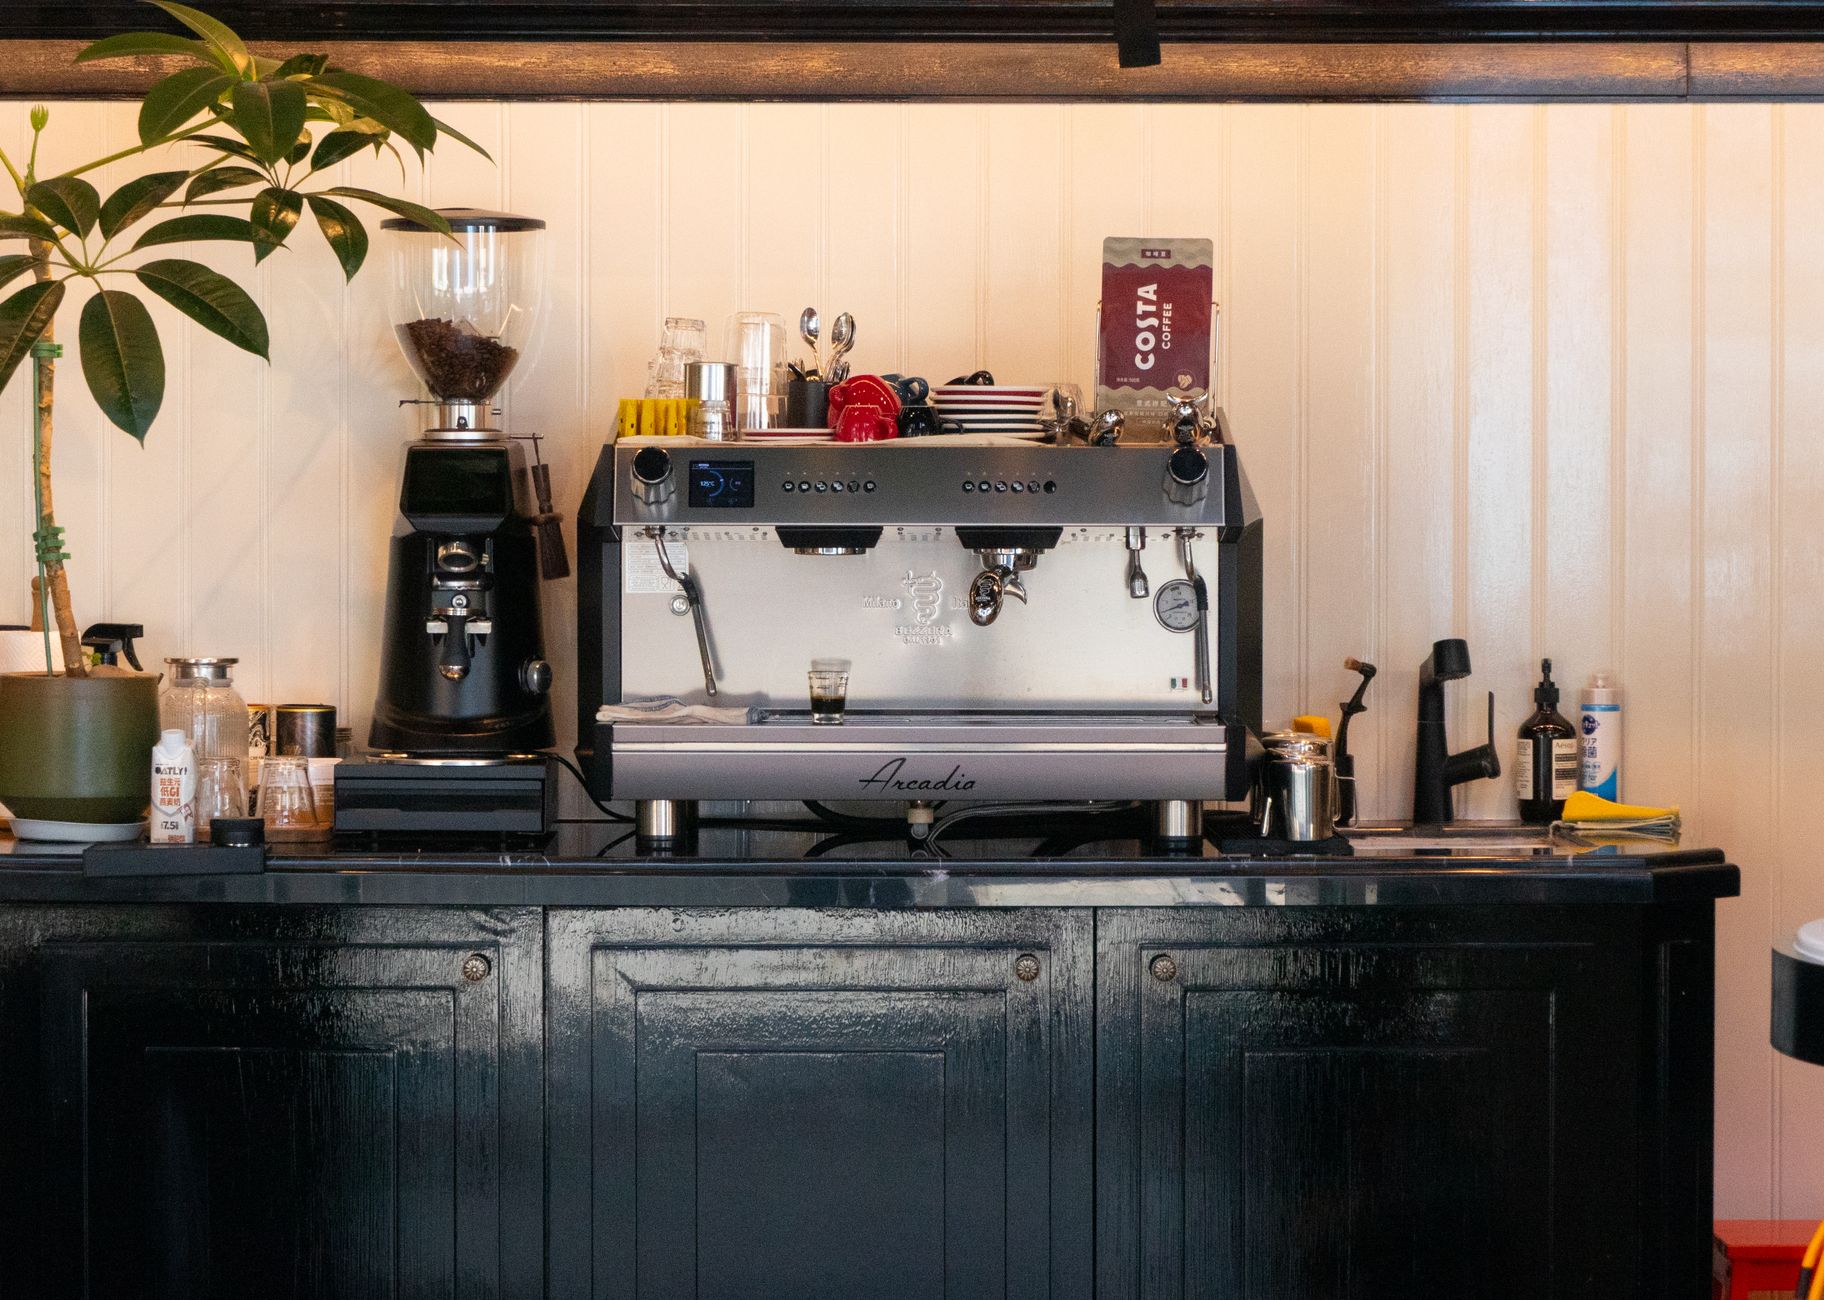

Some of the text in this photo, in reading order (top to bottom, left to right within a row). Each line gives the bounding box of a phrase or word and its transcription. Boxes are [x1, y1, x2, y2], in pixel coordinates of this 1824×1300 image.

[1134, 283, 1159, 371] COSTA
[1161, 302, 1173, 350] COFFEE
[858, 757, 976, 793] Arcadia
